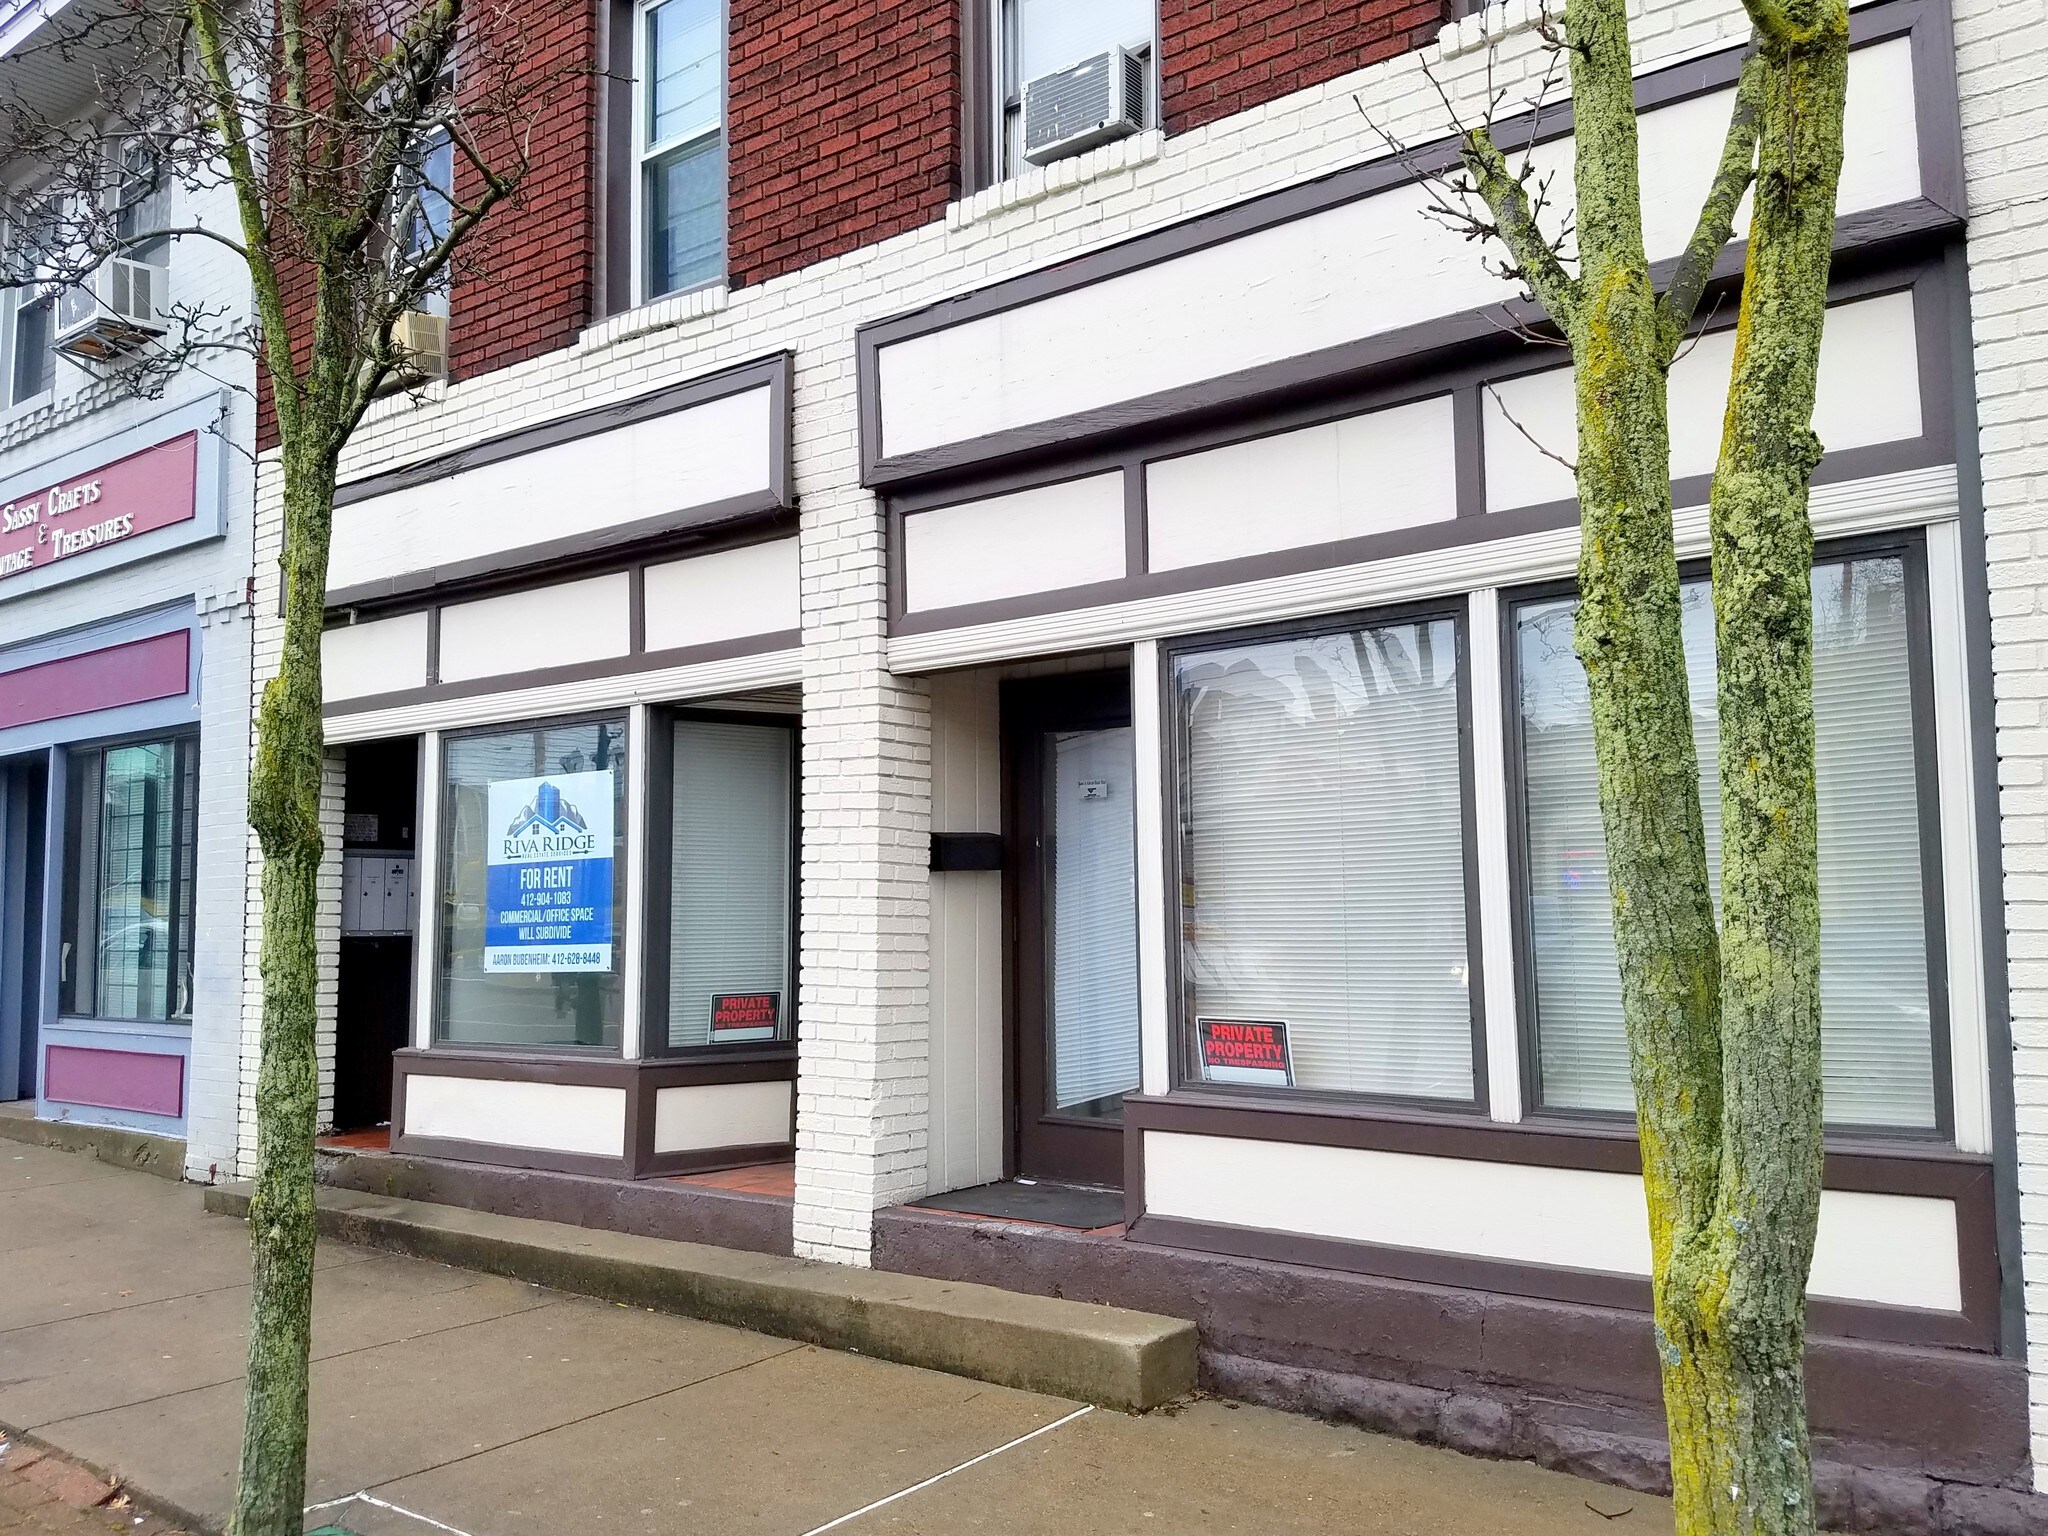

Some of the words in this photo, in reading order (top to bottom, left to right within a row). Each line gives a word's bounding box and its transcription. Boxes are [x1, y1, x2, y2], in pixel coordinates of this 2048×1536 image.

[2, 502, 41, 533] SASSY
[48, 479, 101, 516] CRAFTS
[51, 513, 134, 559] TREASURES
[504, 839, 539, 854] RIVA
[543, 834, 595, 851] RIDGE
[520, 868, 541, 889] FOR
[544, 866, 573, 888] RENT
[521, 891, 571, 906] 412-904-1083
[500, 908, 570, 924] COMMERCIAL/OFFICE
[571, 907, 594, 921] SPACE
[519, 926, 534, 940] WILL
[536, 925, 571, 939] SUBDIVIDE
[493, 954, 511, 965] AARON
[552, 952, 601, 965] 412-628-8448
[722, 997, 770, 1009] PRIVATE
[715, 1009, 775, 1022] PROPERTY
[1211, 1024, 1274, 1043] PRIVATE
[1206, 1041, 1282, 1059] PROPERTY
[1224, 1058, 1285, 1069] TRESPASSING
